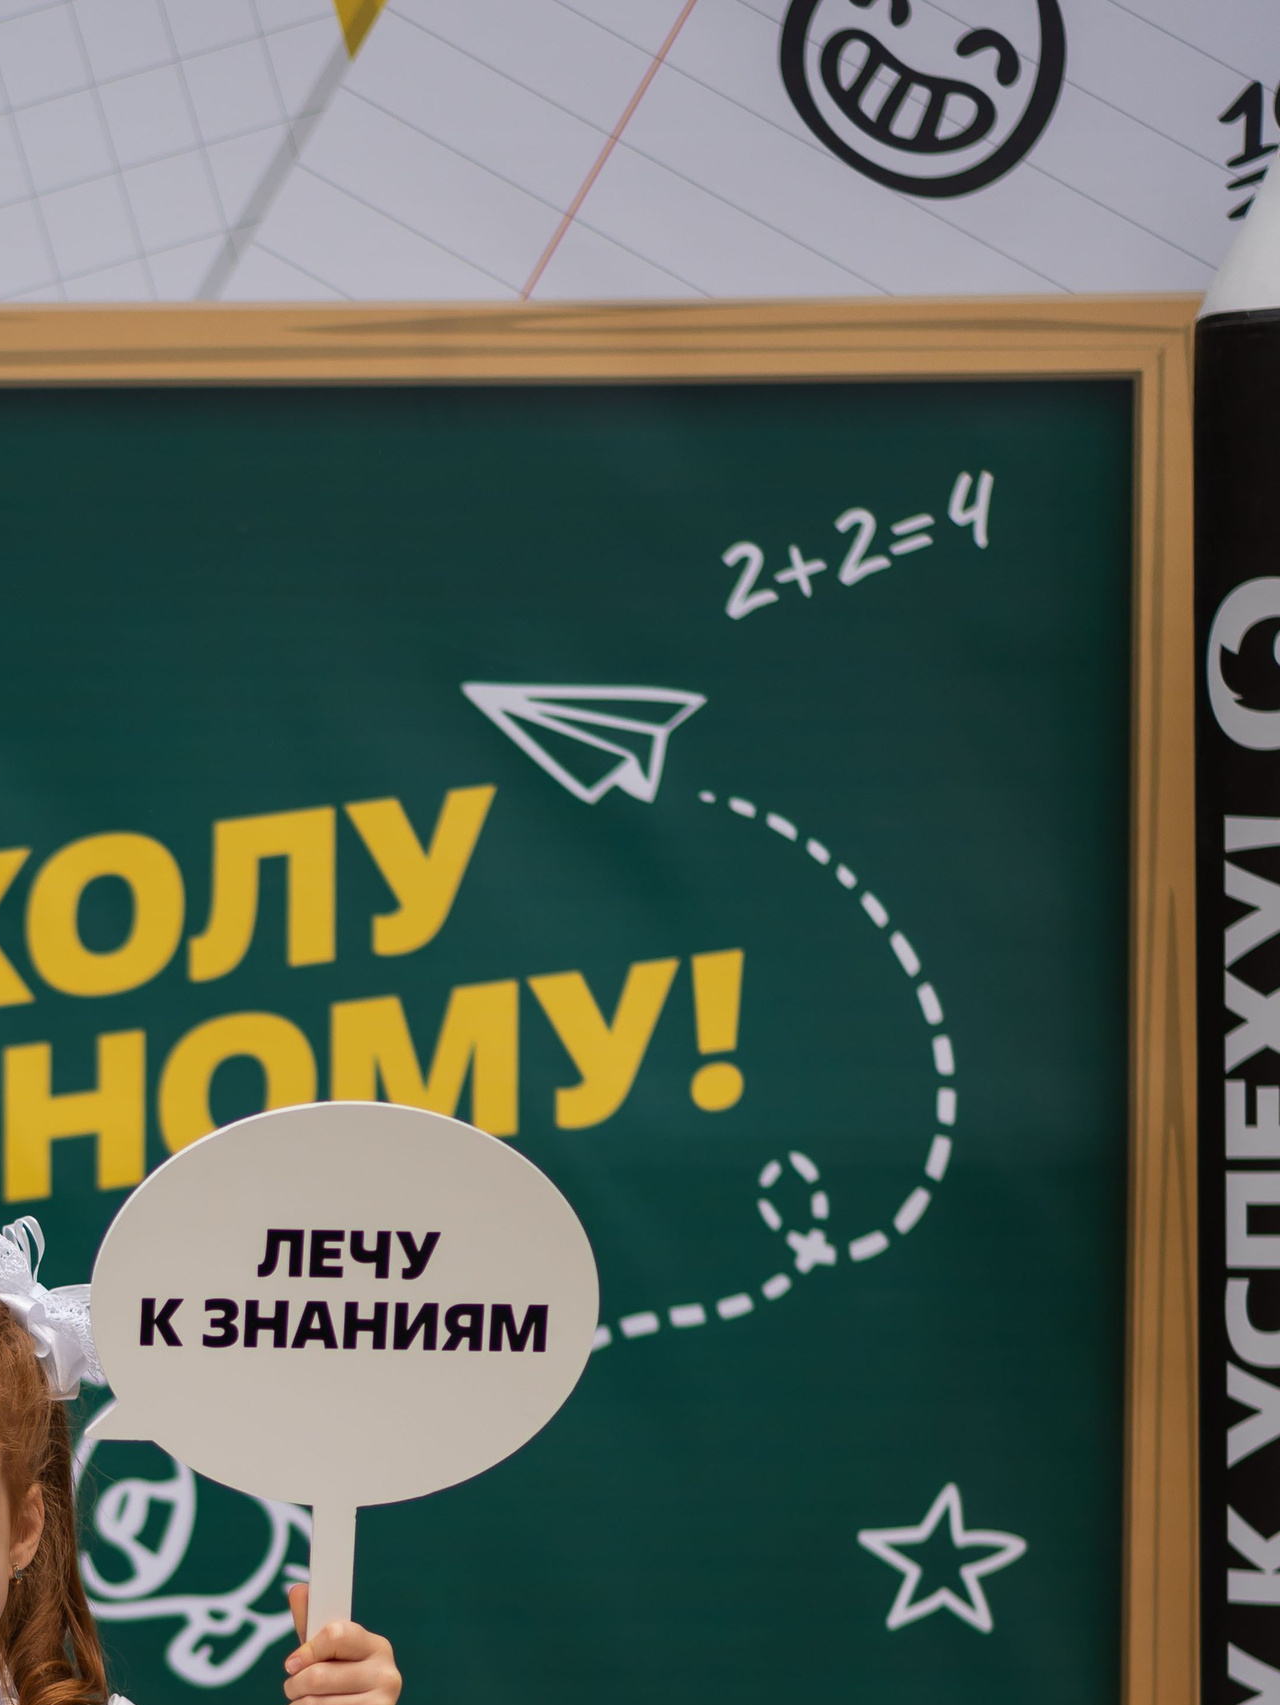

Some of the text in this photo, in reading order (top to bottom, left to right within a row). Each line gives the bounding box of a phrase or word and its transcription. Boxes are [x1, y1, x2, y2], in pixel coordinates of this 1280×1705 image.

[1218, 80, 1280, 168] 1
[257, 1228, 441, 1281] ЛЕЧУ
[138, 1298, 550, 1354] К ЗНАНИЯМ
